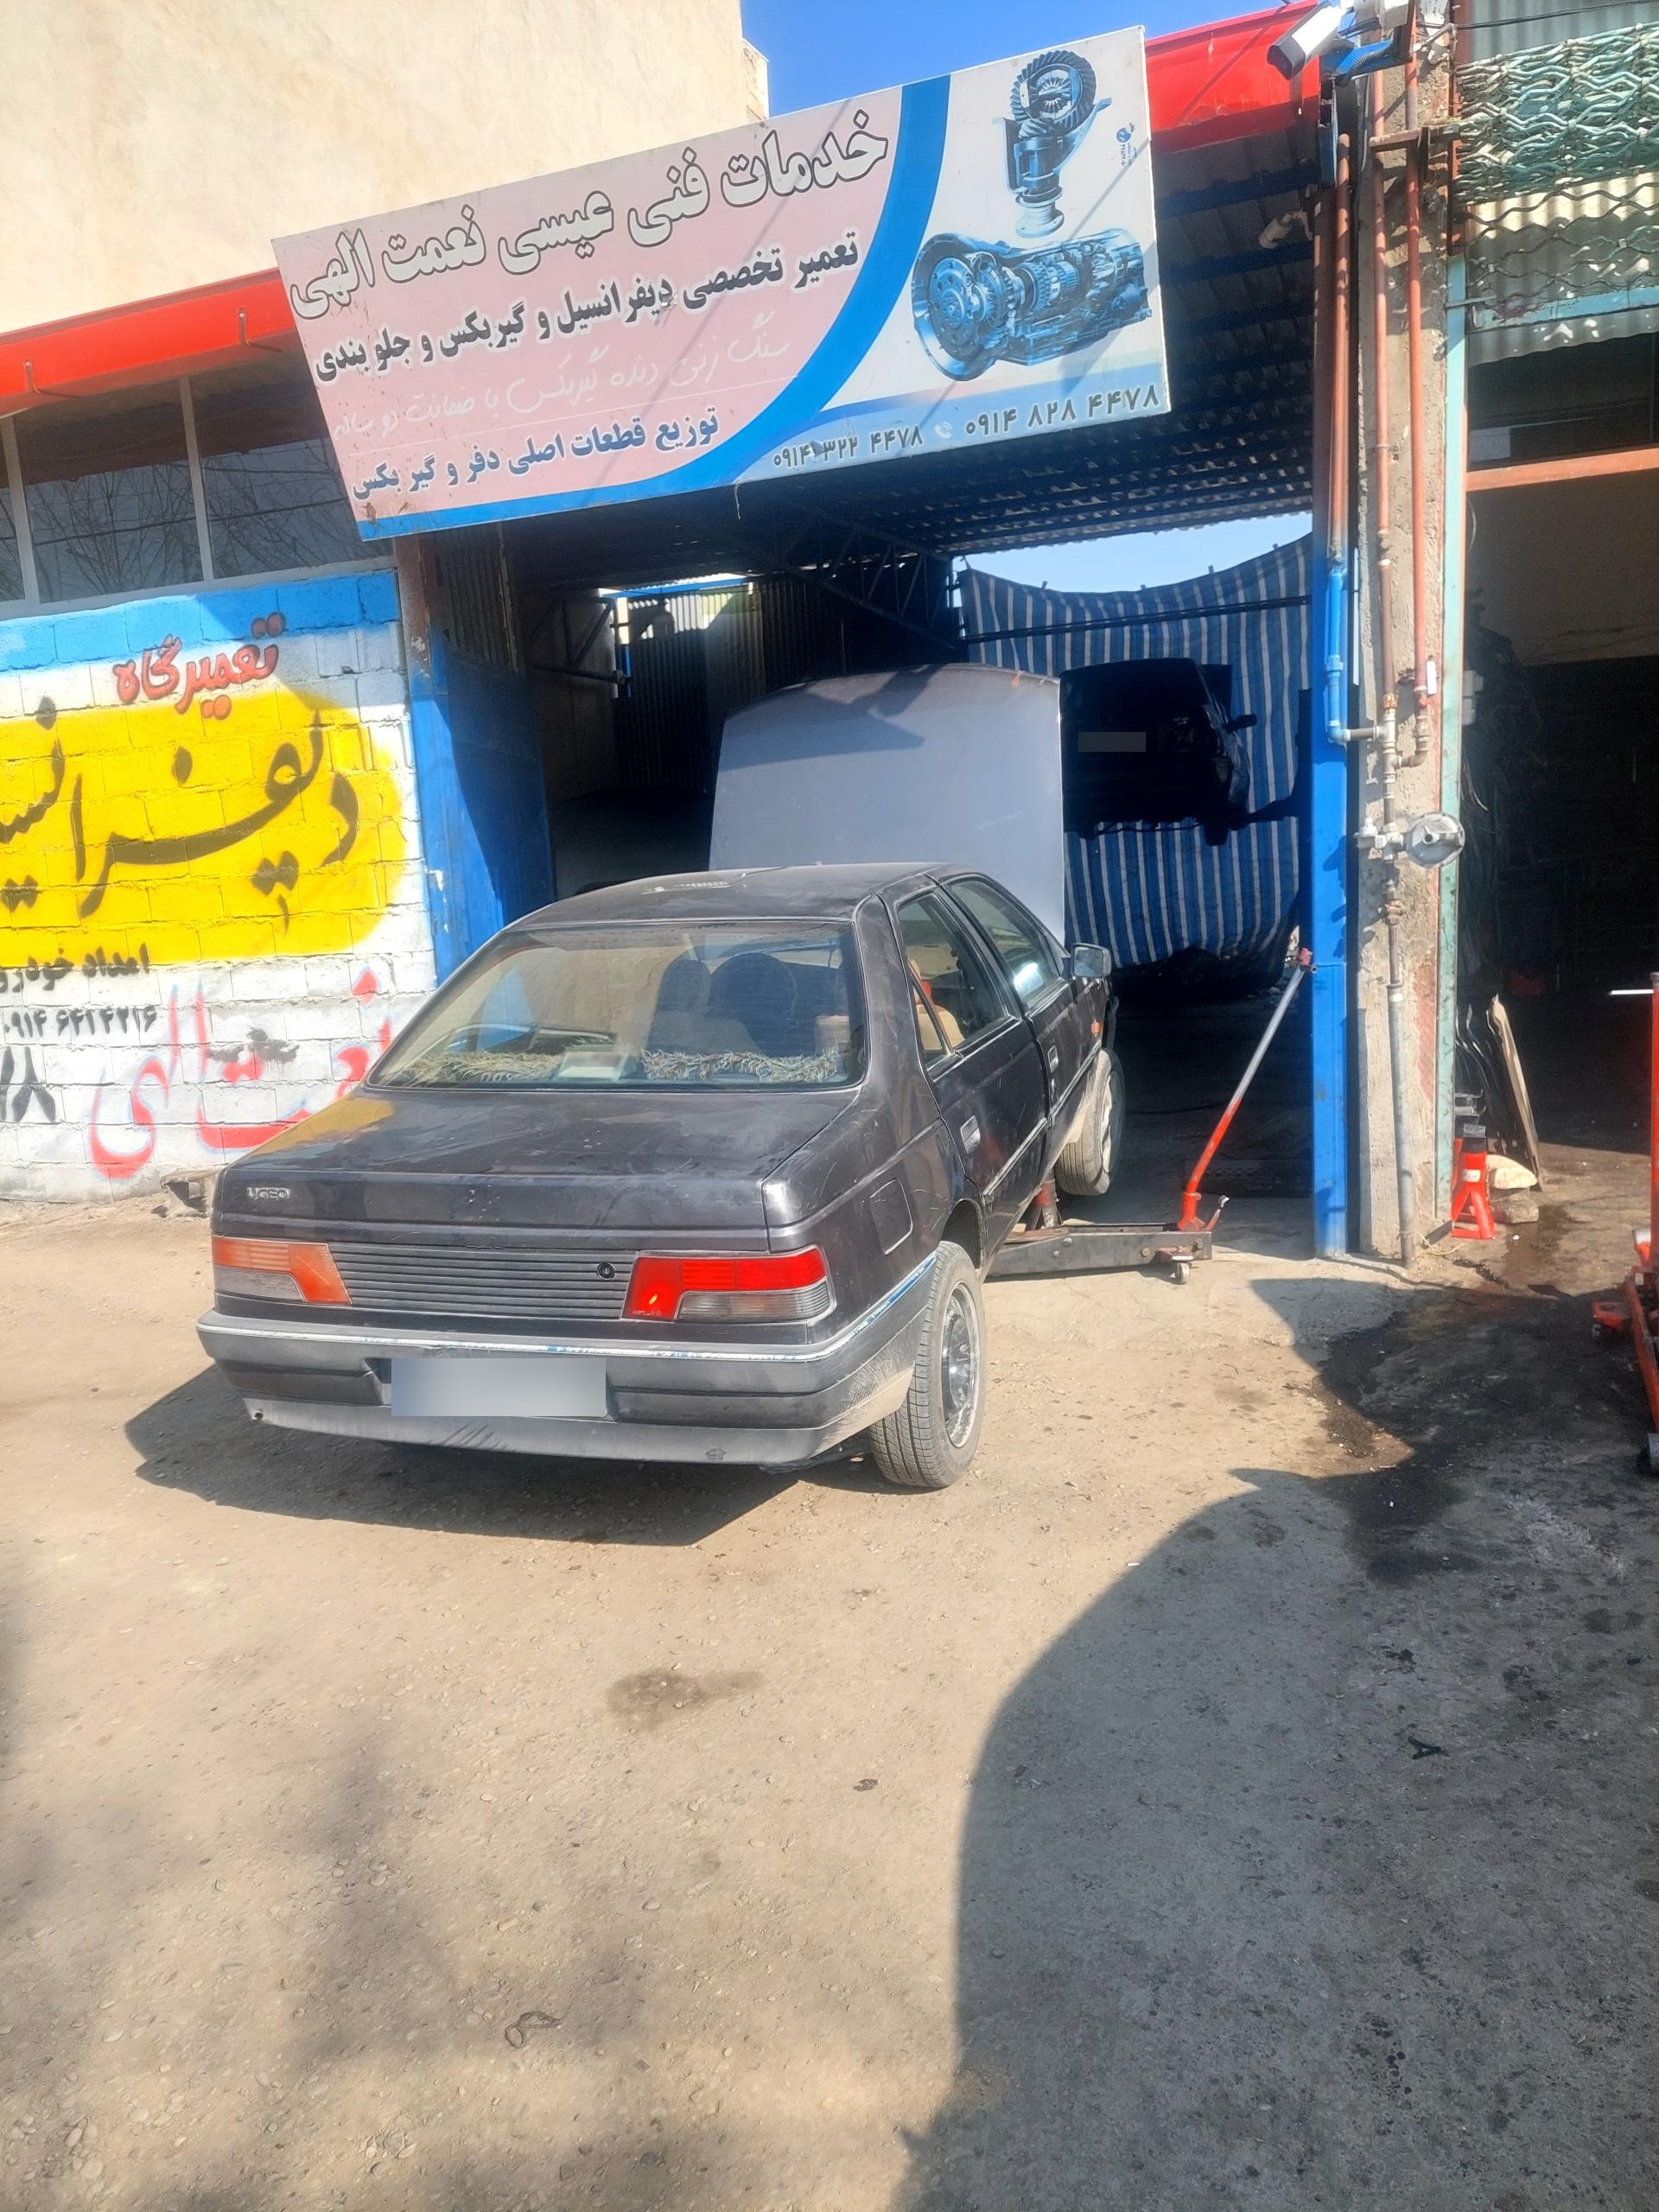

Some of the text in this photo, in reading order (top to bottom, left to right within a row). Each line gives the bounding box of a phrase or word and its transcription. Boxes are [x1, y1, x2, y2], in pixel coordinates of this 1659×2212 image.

[290, 109, 889, 320] خدمات فنی عیسی نعمت الهی
[683, 248, 784, 308] تخصصی
[794, 232, 859, 289] تعمیر
[537, 310, 550, 340] و
[557, 277, 673, 334] دیفرانسیل
[421, 334, 433, 363] و
[440, 302, 524, 357] گیربکس
[655, 407, 719, 452] توزیع
[965, 385, 1159, 435] ۰۹۱۴ ۸۲۸ ۴۴۷۸
[508, 433, 565, 474] اصلی
[571, 416, 646, 456] قطعات
[773, 443, 810, 467] ۰۹۱۴
[870, 426, 923, 454] ۴۴۷۸
[447, 462, 459, 486] و
[467, 445, 500, 482] دفر
[112, 611, 285, 721] تعمیرگاه
[3, 1009, 48, 1039] ۰۹۱۴
